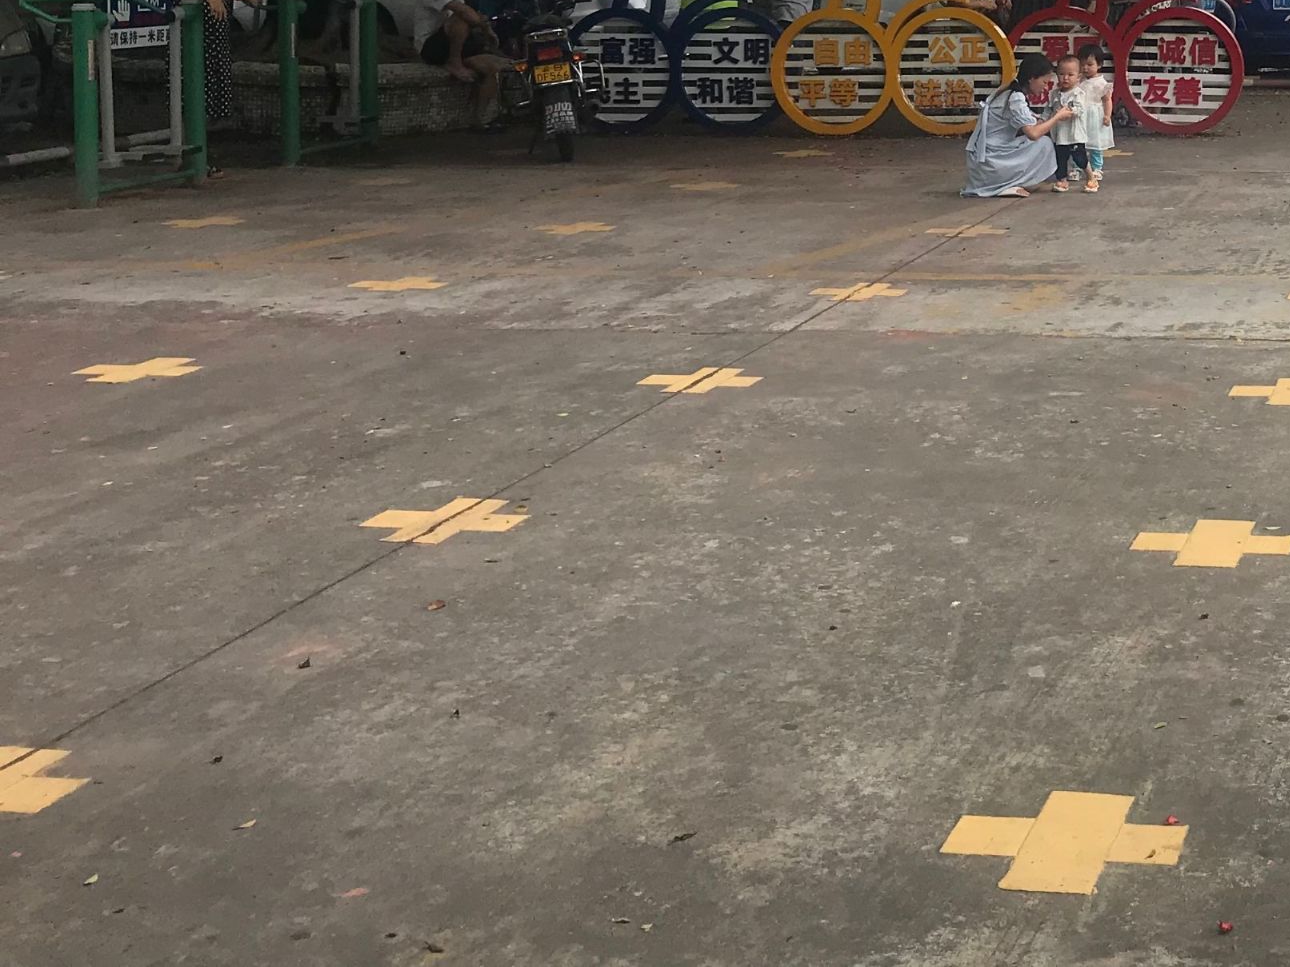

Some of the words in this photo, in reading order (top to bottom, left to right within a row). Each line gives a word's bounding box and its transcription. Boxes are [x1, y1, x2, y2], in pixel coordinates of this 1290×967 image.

[600, 37, 656, 65] 富强
[713, 37, 770, 65] 文明
[814, 36, 873, 66] 自由
[928, 36, 989, 65] 公正
[1158, 36, 1218, 66] 诚信
[697, 77, 755, 105] 和谐
[799, 78, 858, 107] 平等
[913, 78, 975, 108] 法治
[1143, 76, 1202, 106] 友善
